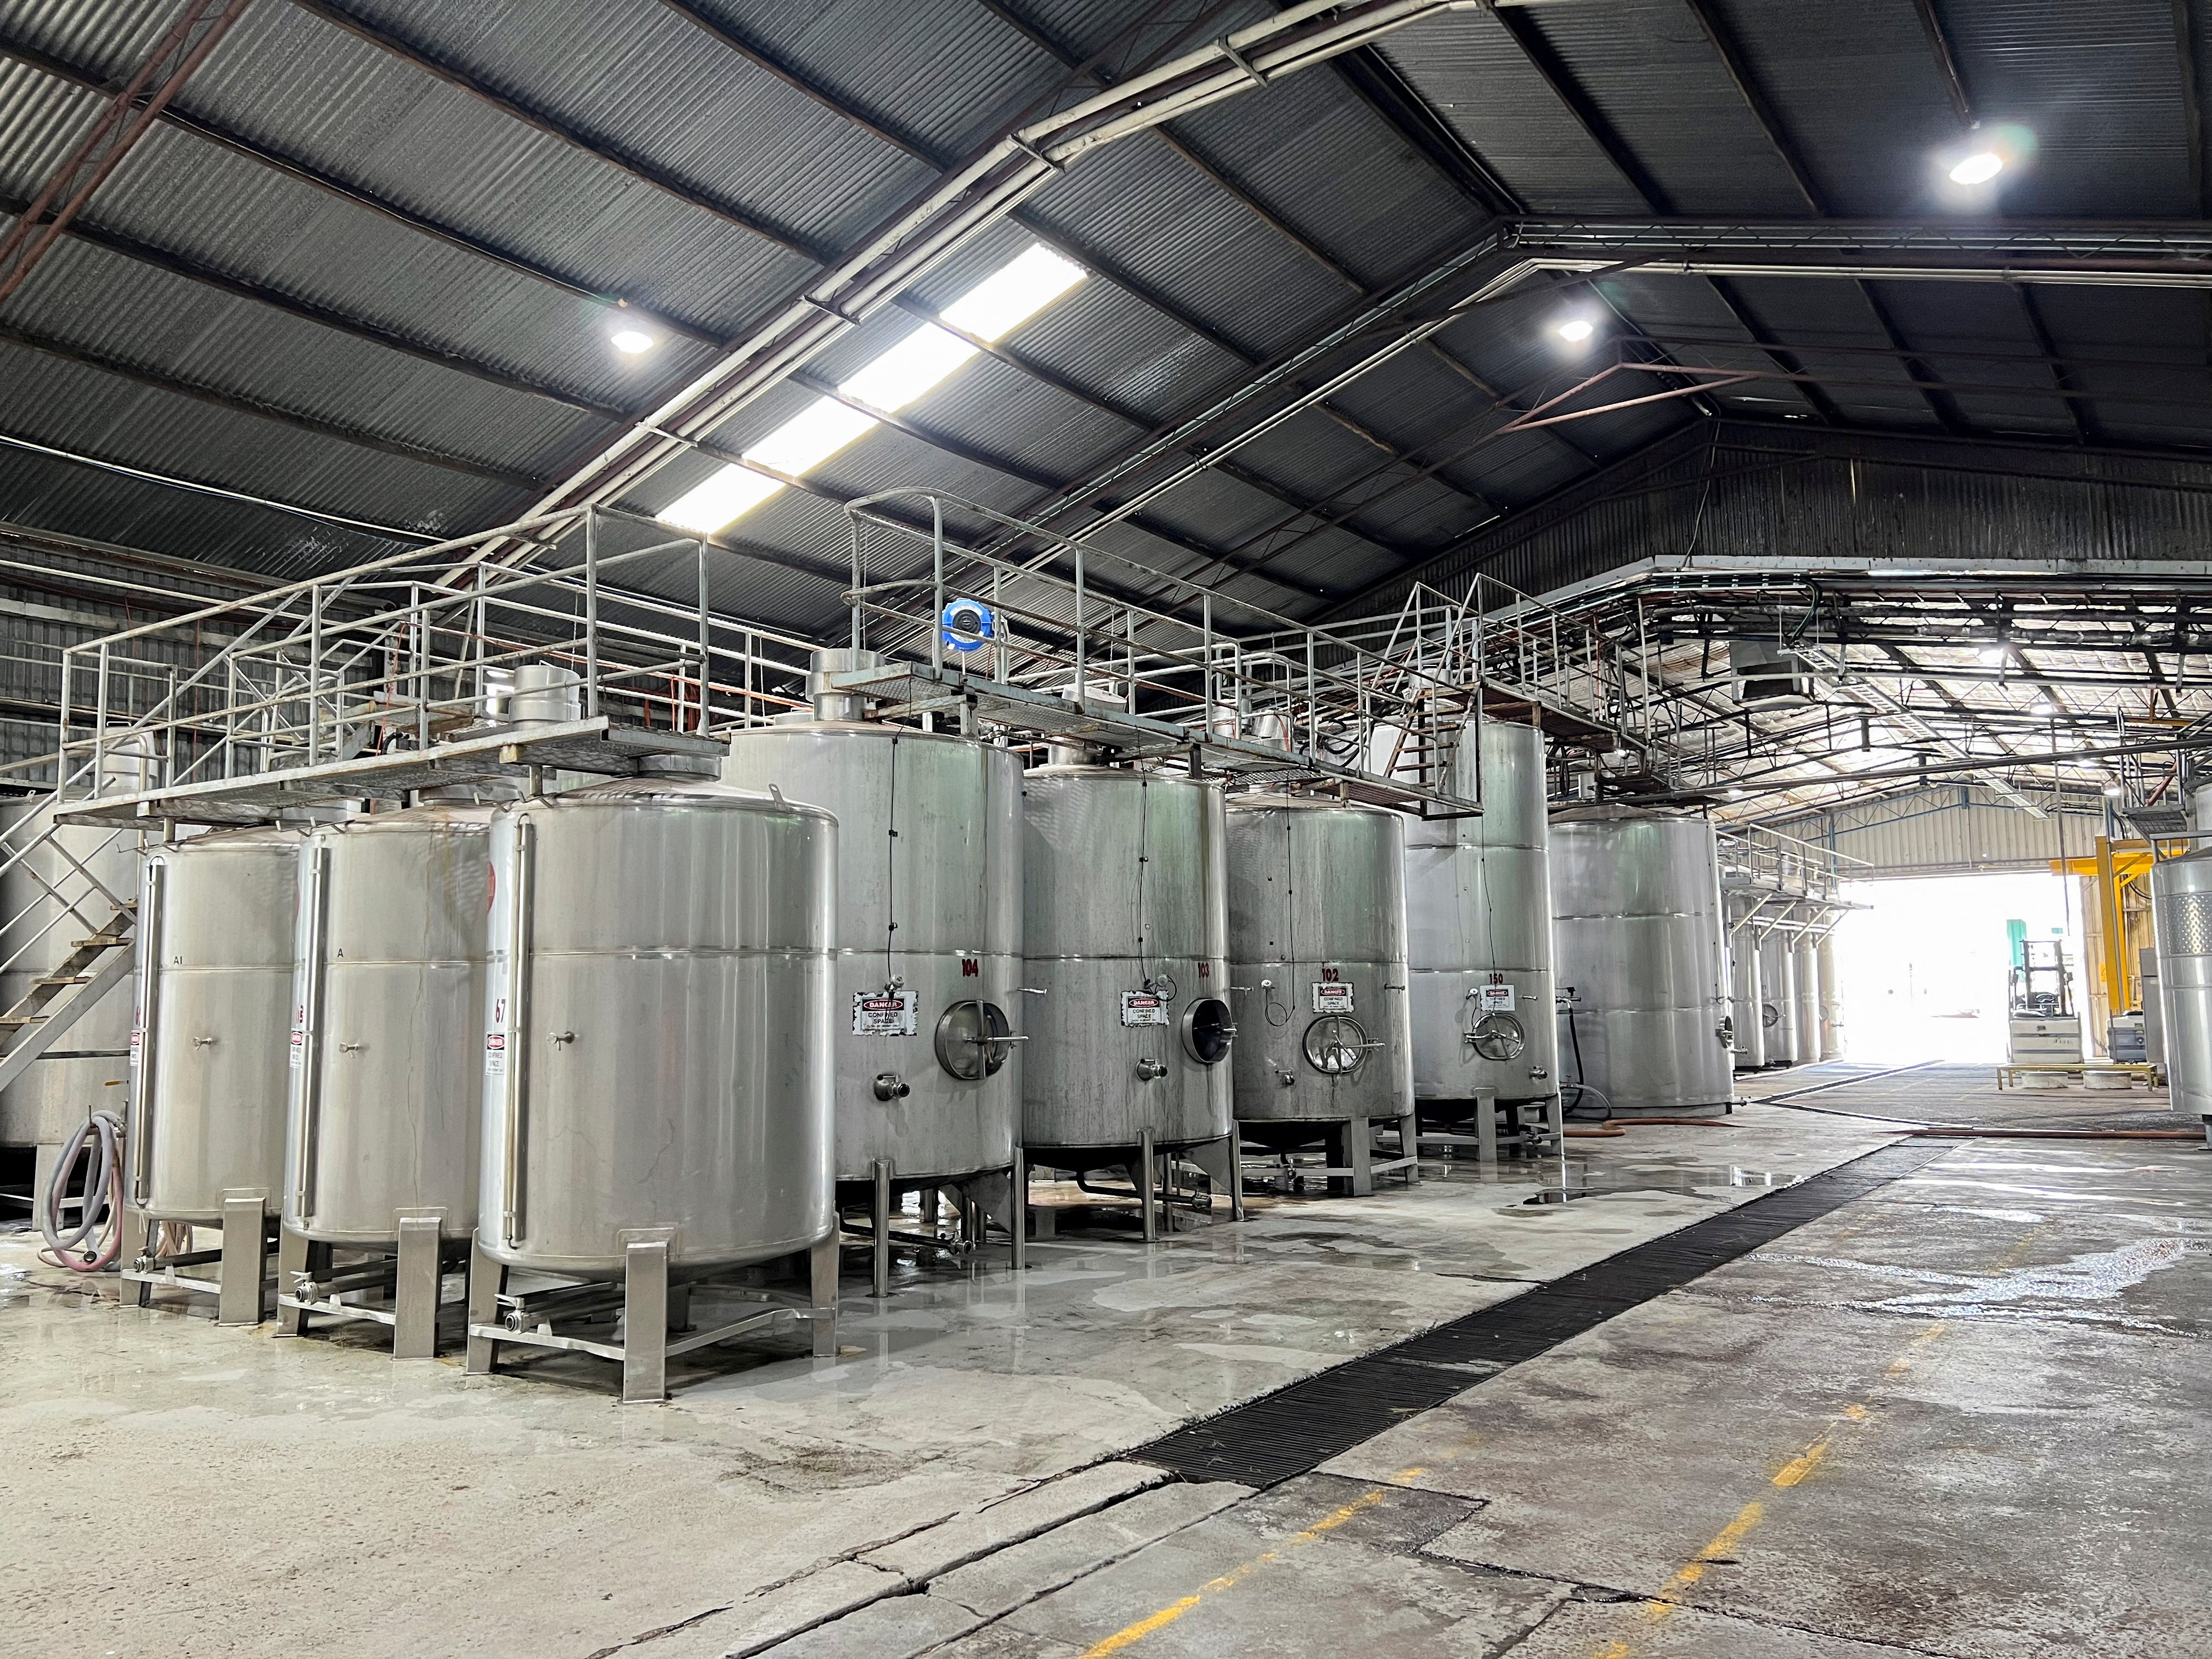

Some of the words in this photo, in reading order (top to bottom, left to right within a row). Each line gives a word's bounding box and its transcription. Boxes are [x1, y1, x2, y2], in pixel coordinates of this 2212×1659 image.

[962, 959, 979, 977] 104
[1198, 962, 1209, 978] 103
[1322, 968, 1339, 982] 102
[1489, 973, 1503, 984] 150
[496, 998, 506, 1023] 67
